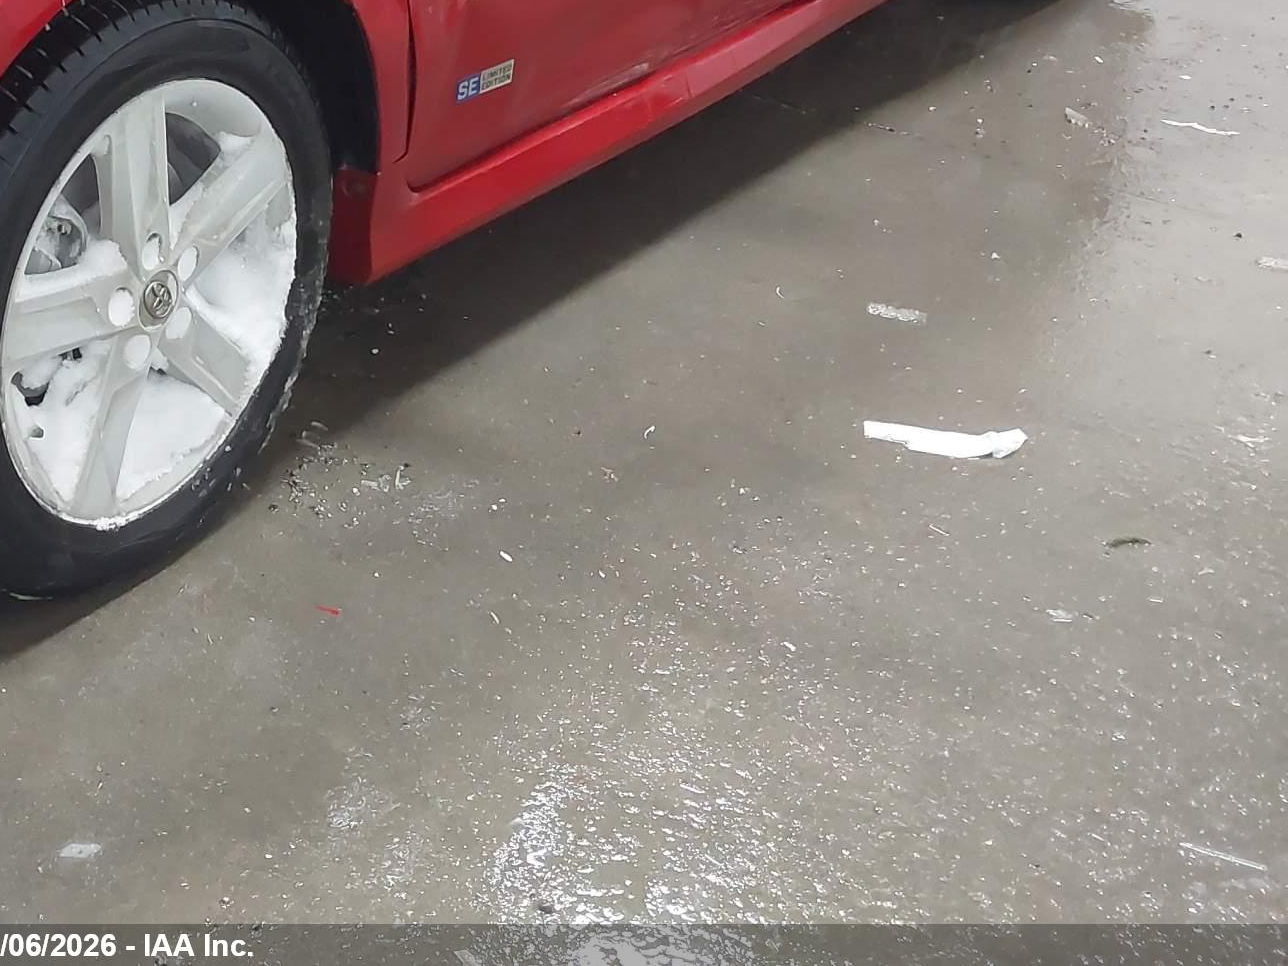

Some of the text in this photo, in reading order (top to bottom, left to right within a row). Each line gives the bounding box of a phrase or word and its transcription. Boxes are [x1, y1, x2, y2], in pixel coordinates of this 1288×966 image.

[482, 62, 513, 81] LIMITED
[457, 77, 479, 101] SE
[481, 73, 511, 90] EDITION
